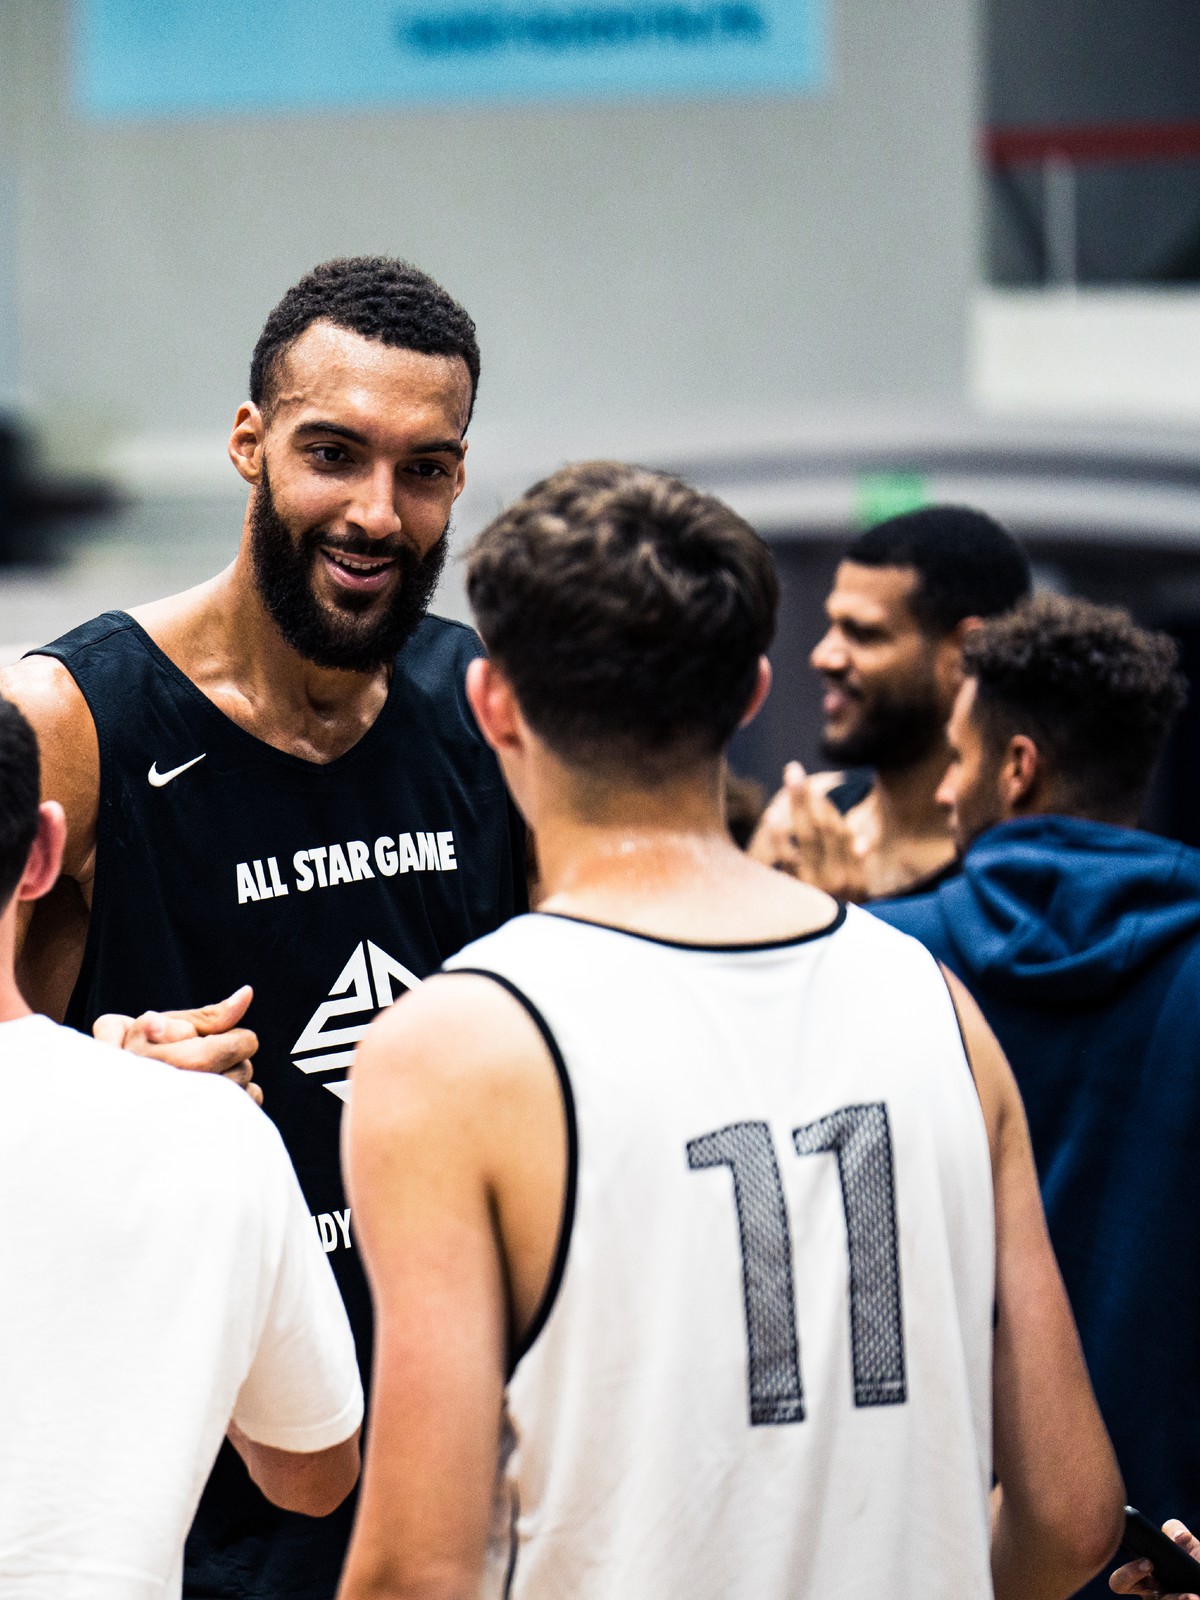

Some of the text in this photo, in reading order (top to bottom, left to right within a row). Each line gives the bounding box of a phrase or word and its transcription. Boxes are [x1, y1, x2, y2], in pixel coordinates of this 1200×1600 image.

[236, 830, 458, 904] ALL STAR GAME
[311, 1208, 351, 1253] DY
[686, 1101, 908, 1426] 11
